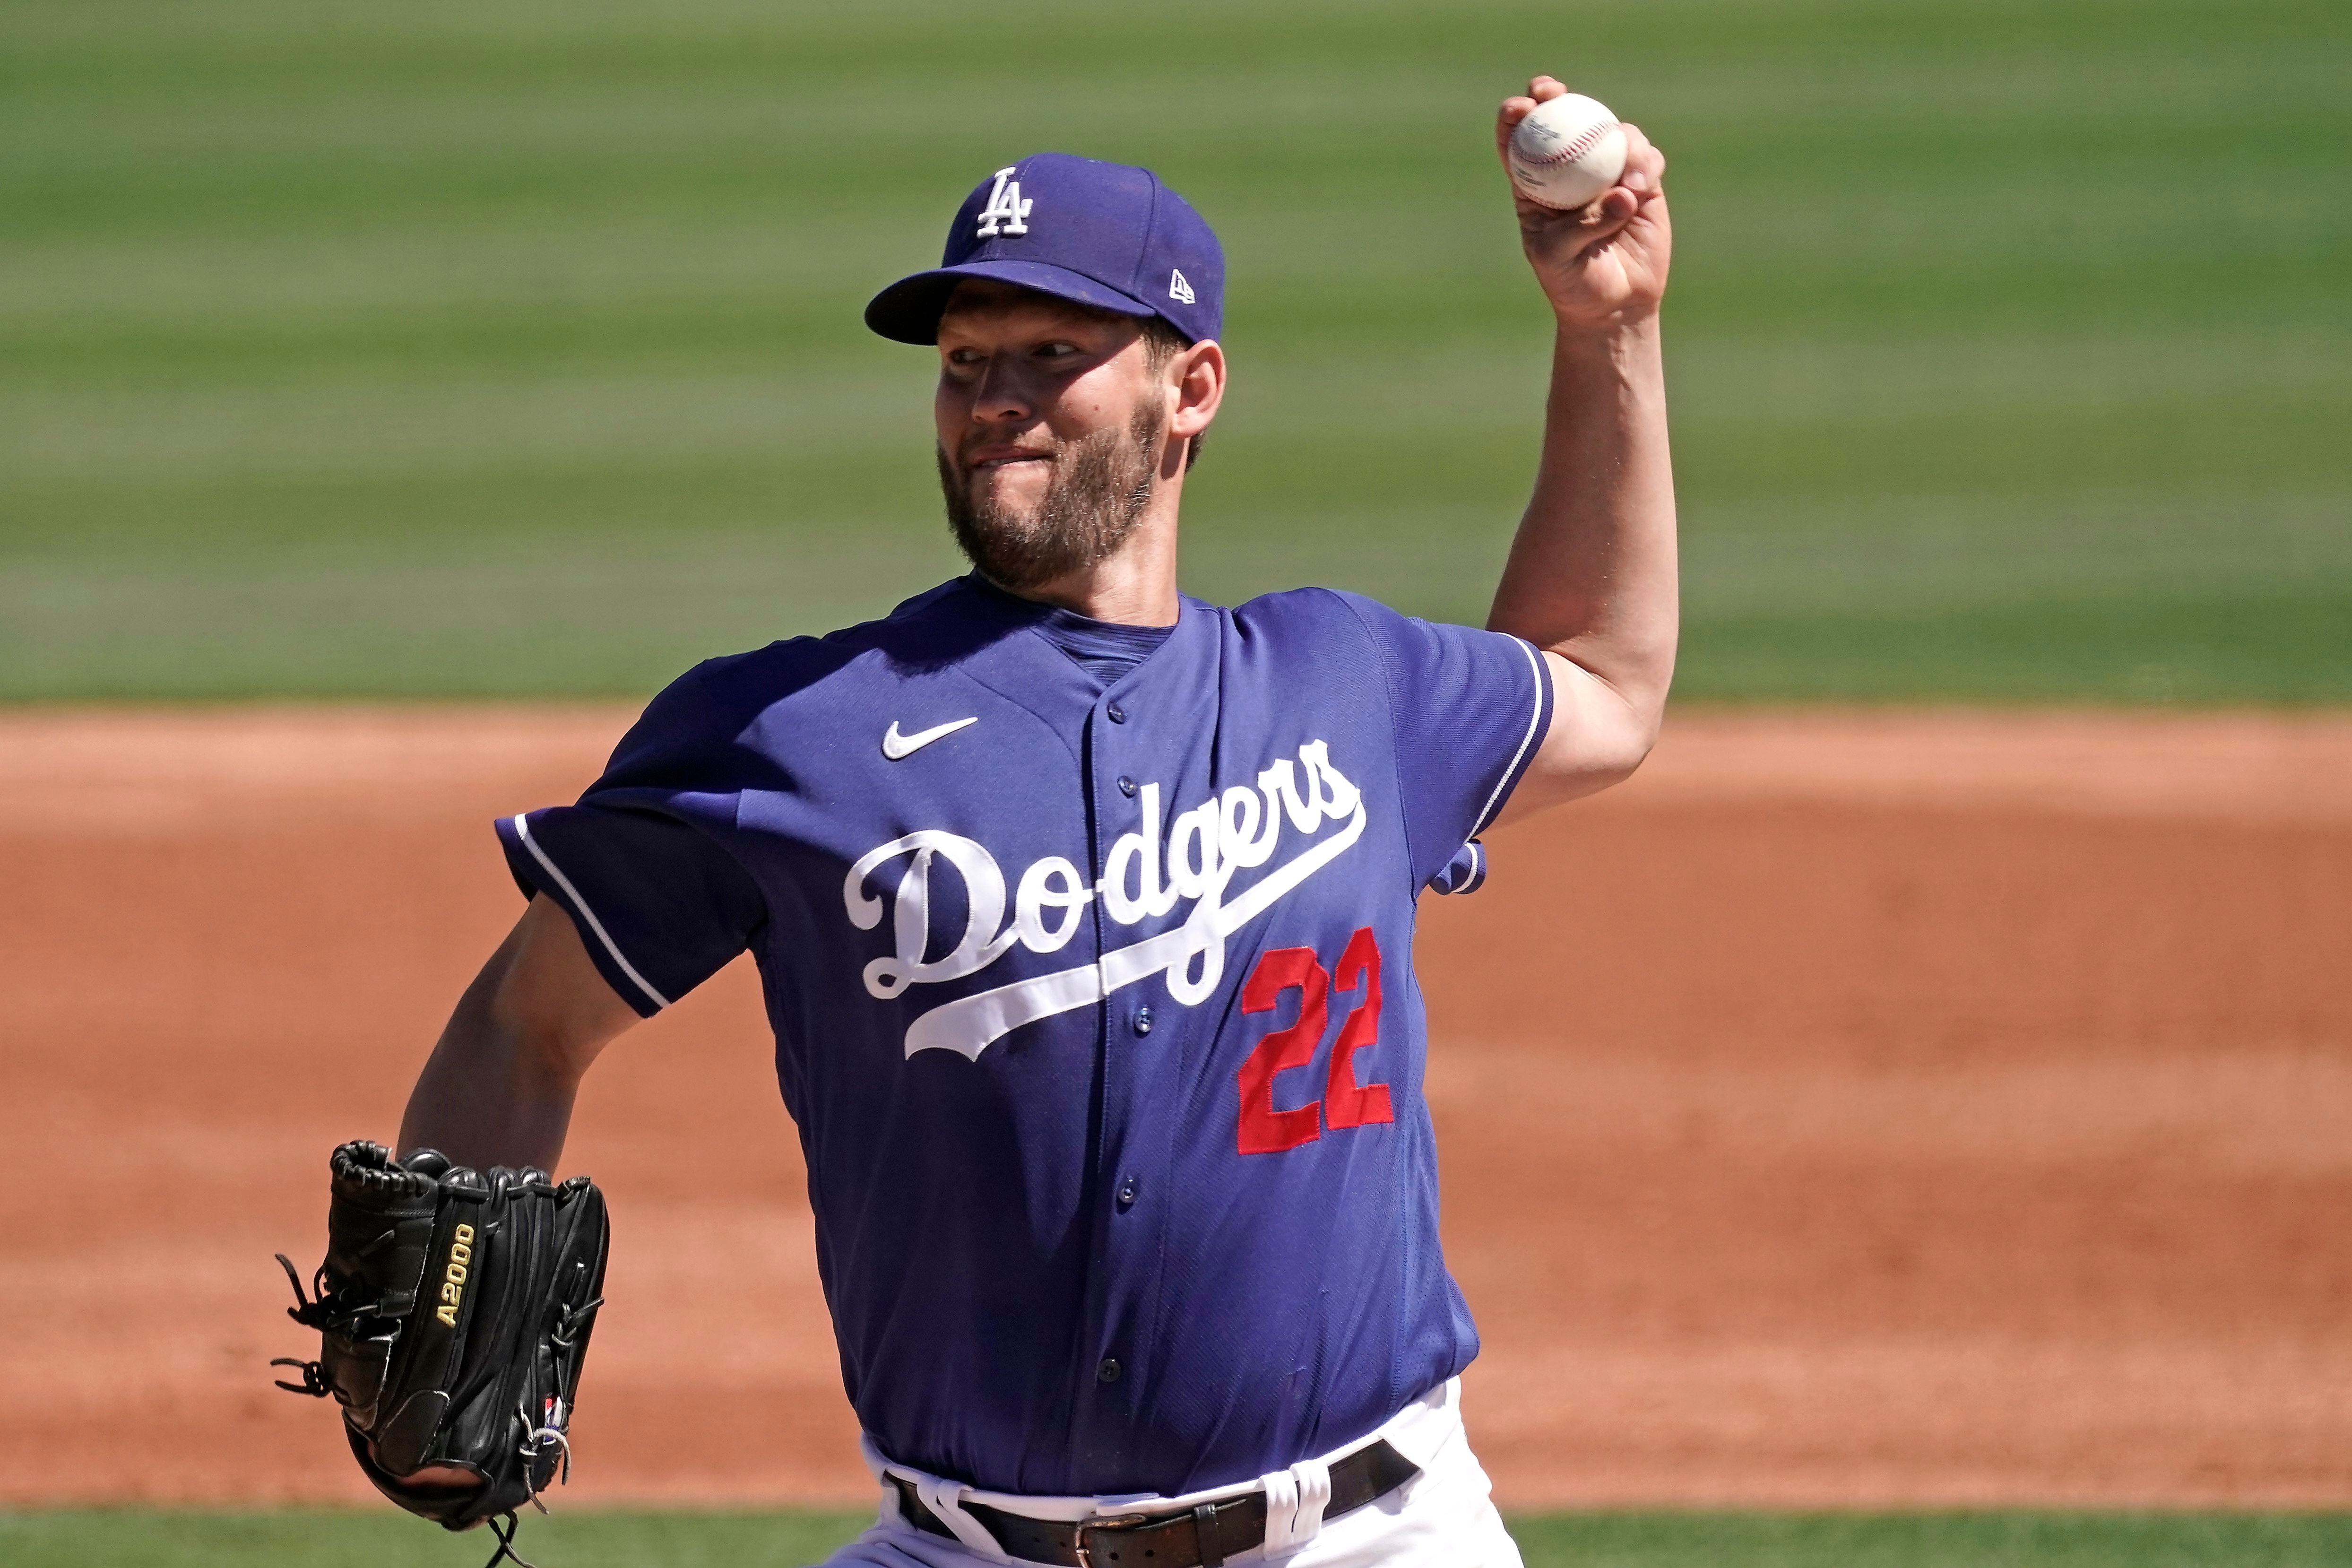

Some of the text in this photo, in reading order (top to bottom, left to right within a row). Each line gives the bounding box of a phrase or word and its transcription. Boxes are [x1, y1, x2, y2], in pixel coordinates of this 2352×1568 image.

[977, 166, 1033, 238] LA
[844, 739, 1361, 1006] Dodgers
[1237, 927, 1393, 1155] 22
[436, 1223, 475, 1329] A2000
